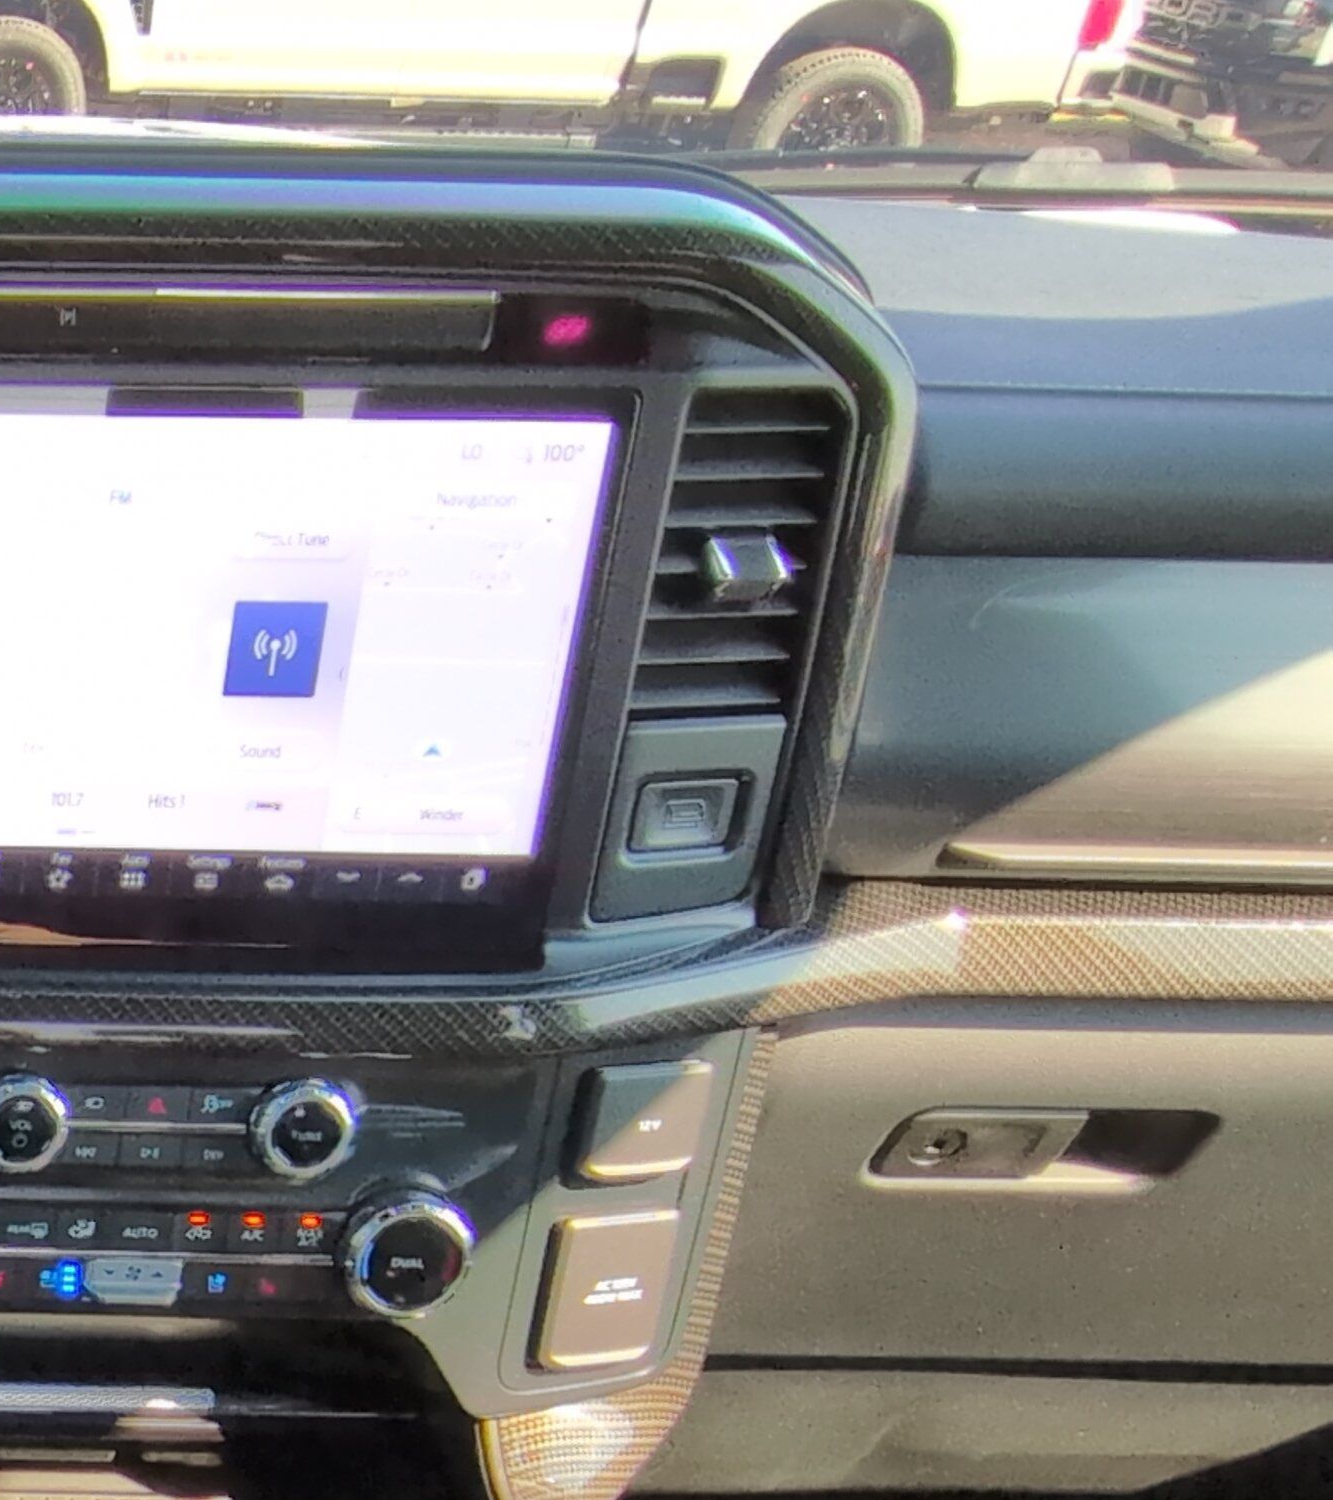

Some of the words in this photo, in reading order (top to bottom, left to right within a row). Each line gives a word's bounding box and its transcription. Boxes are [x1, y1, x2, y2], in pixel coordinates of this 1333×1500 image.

[109, 489, 132, 504] FM
[436, 492, 518, 509] Navigation
[238, 744, 283, 760] Sound
[147, 794, 177, 809] Hits
[122, 1226, 159, 1239] AUTO
[241, 1230, 264, 1241] A/C
[390, 1257, 424, 1270] DUAL
